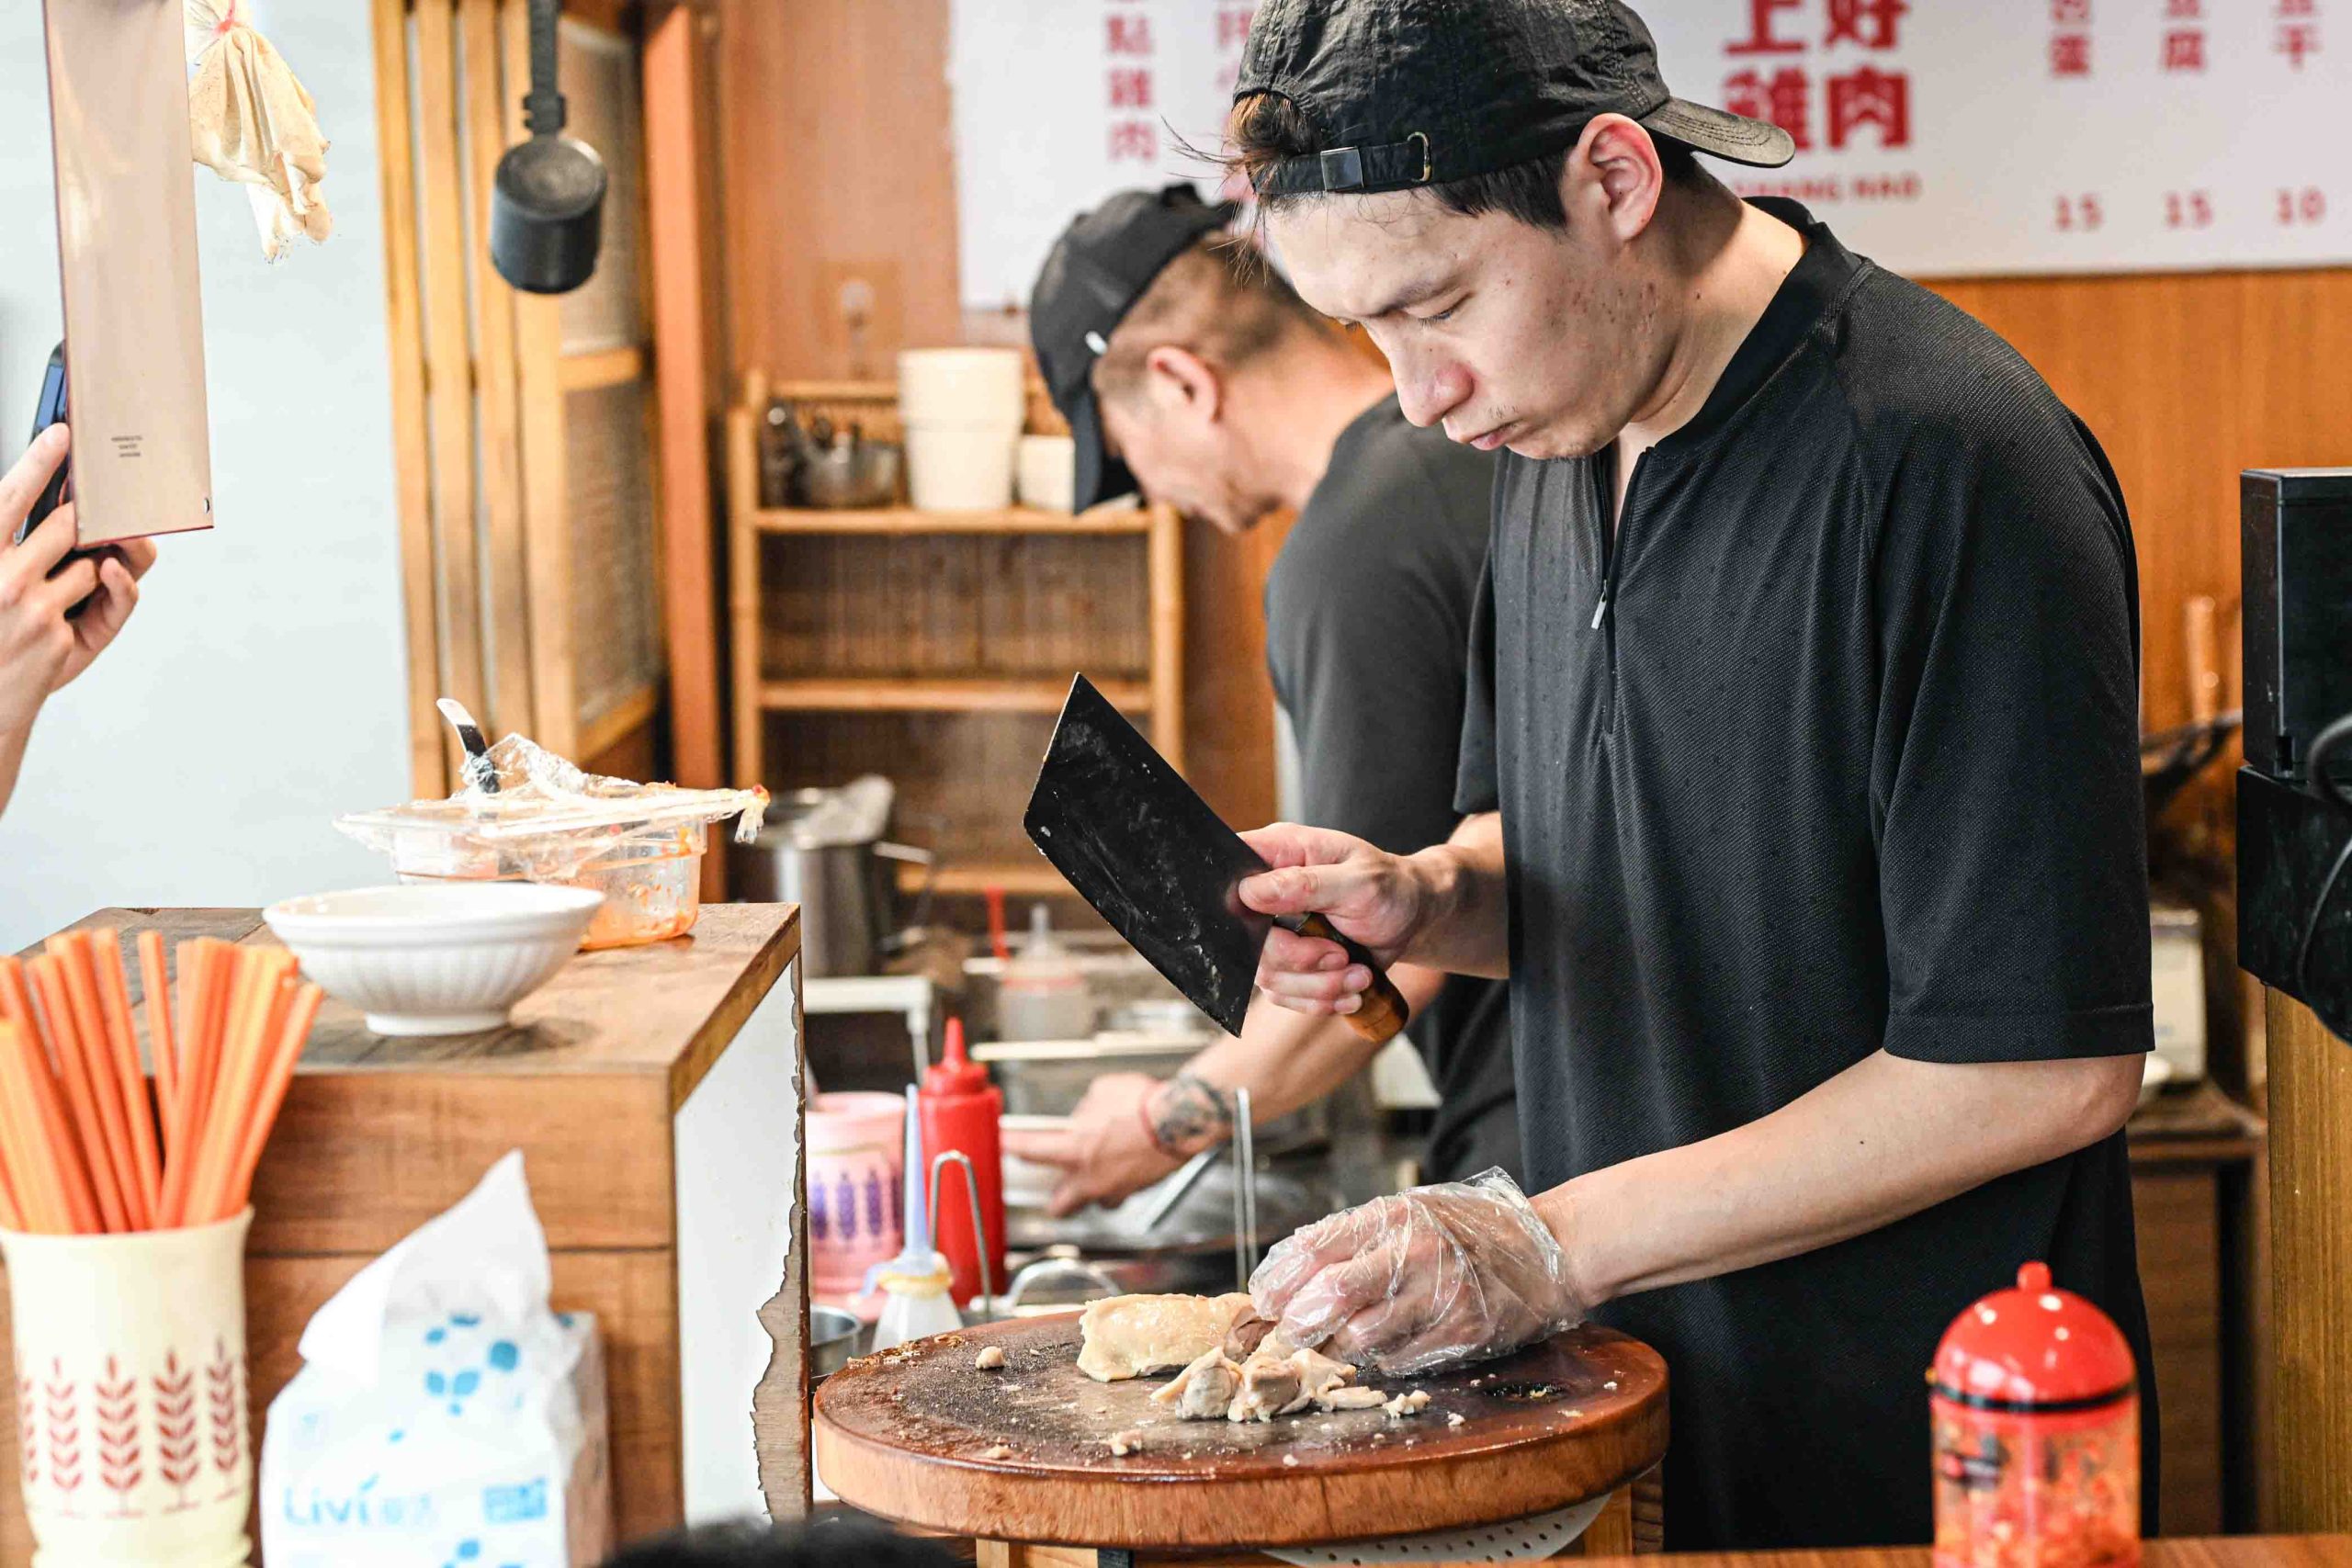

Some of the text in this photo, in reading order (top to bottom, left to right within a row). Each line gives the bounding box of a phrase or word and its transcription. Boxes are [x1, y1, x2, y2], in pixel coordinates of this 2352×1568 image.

[2054, 193, 2103, 231] 15
[2165, 191, 2214, 229] 15
[2277, 187, 2326, 226] 10
